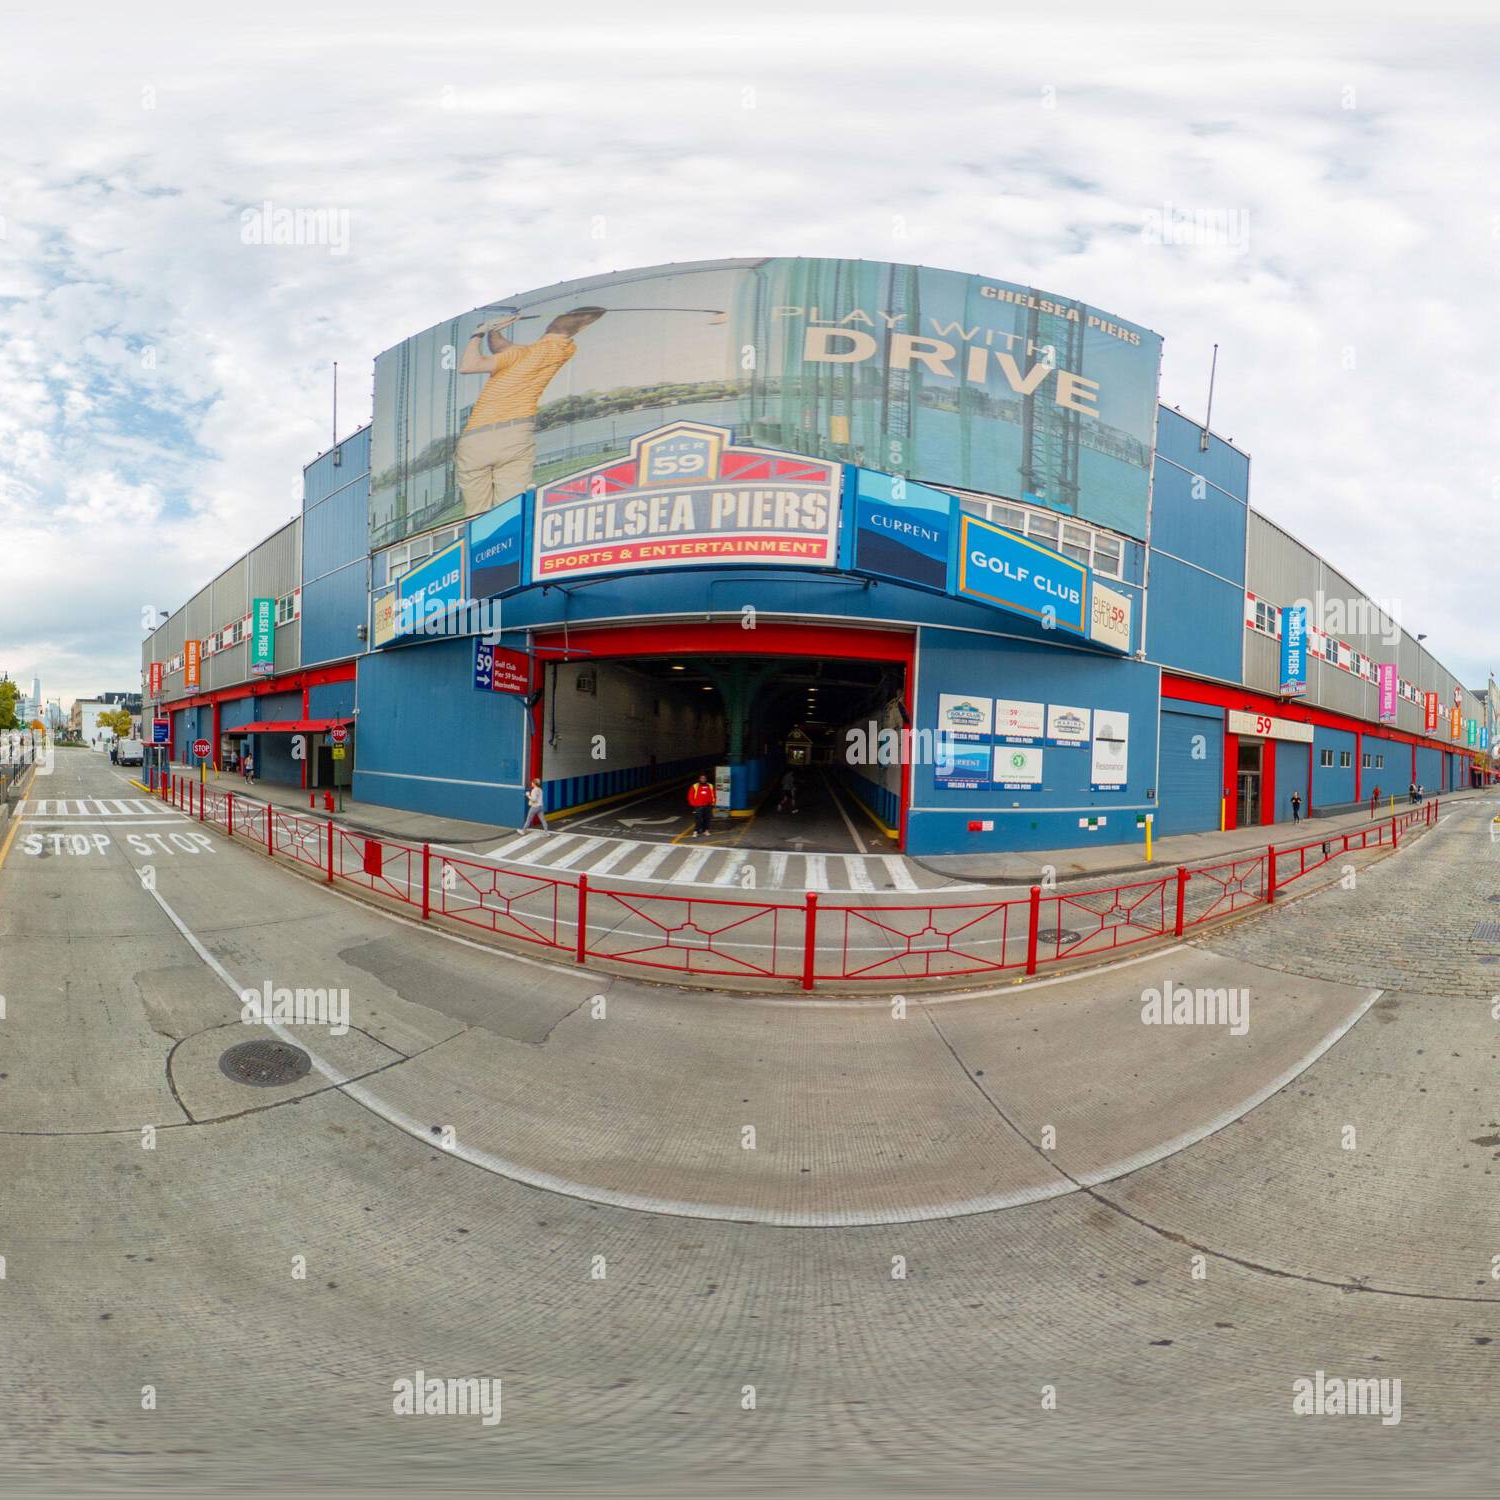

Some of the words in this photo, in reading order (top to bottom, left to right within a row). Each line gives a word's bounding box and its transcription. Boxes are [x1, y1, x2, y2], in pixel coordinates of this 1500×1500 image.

[979, 285, 1080, 322] CHELSEA
[1087, 314, 1141, 347] PIERS
[771, 305, 908, 330] PLAY
[929, 318, 1051, 361] WITH
[803, 326, 1099, 418] DRIVE
[656, 441, 704, 453] PIER
[652, 454, 705, 476] 59
[542, 495, 696, 548] CHELSEA
[711, 491, 827, 530] PIERS
[871, 513, 940, 543] CURRENT
[475, 537, 514, 563] CURRENT
[543, 551, 613, 570] SPORTS
[619, 549, 632, 559] &
[639, 540, 822, 558] ENTERTAINMENT
[427, 569, 460, 595] CLUB
[970, 550, 1029, 582] GOLF
[1033, 575, 1080, 605] CLUB
[259, 601, 269, 633] CHELSEA
[1093, 596, 1111, 613] PIER
[1111, 606, 1125, 623] 59
[1092, 609, 1129, 637] STUDIOS
[1288, 610, 1300, 647] CHELSEA
[258, 635, 268, 657] PIERS
[476, 654, 493, 672] 59
[494, 660, 506, 669] Golf
[1288, 650, 1299, 675] PIERS
[333, 729, 347, 737] STOP
[1256, 716, 1272, 735] 59
[194, 744, 210, 753] STOP
[23, 833, 110, 856] STOP
[126, 832, 217, 856] STOP
